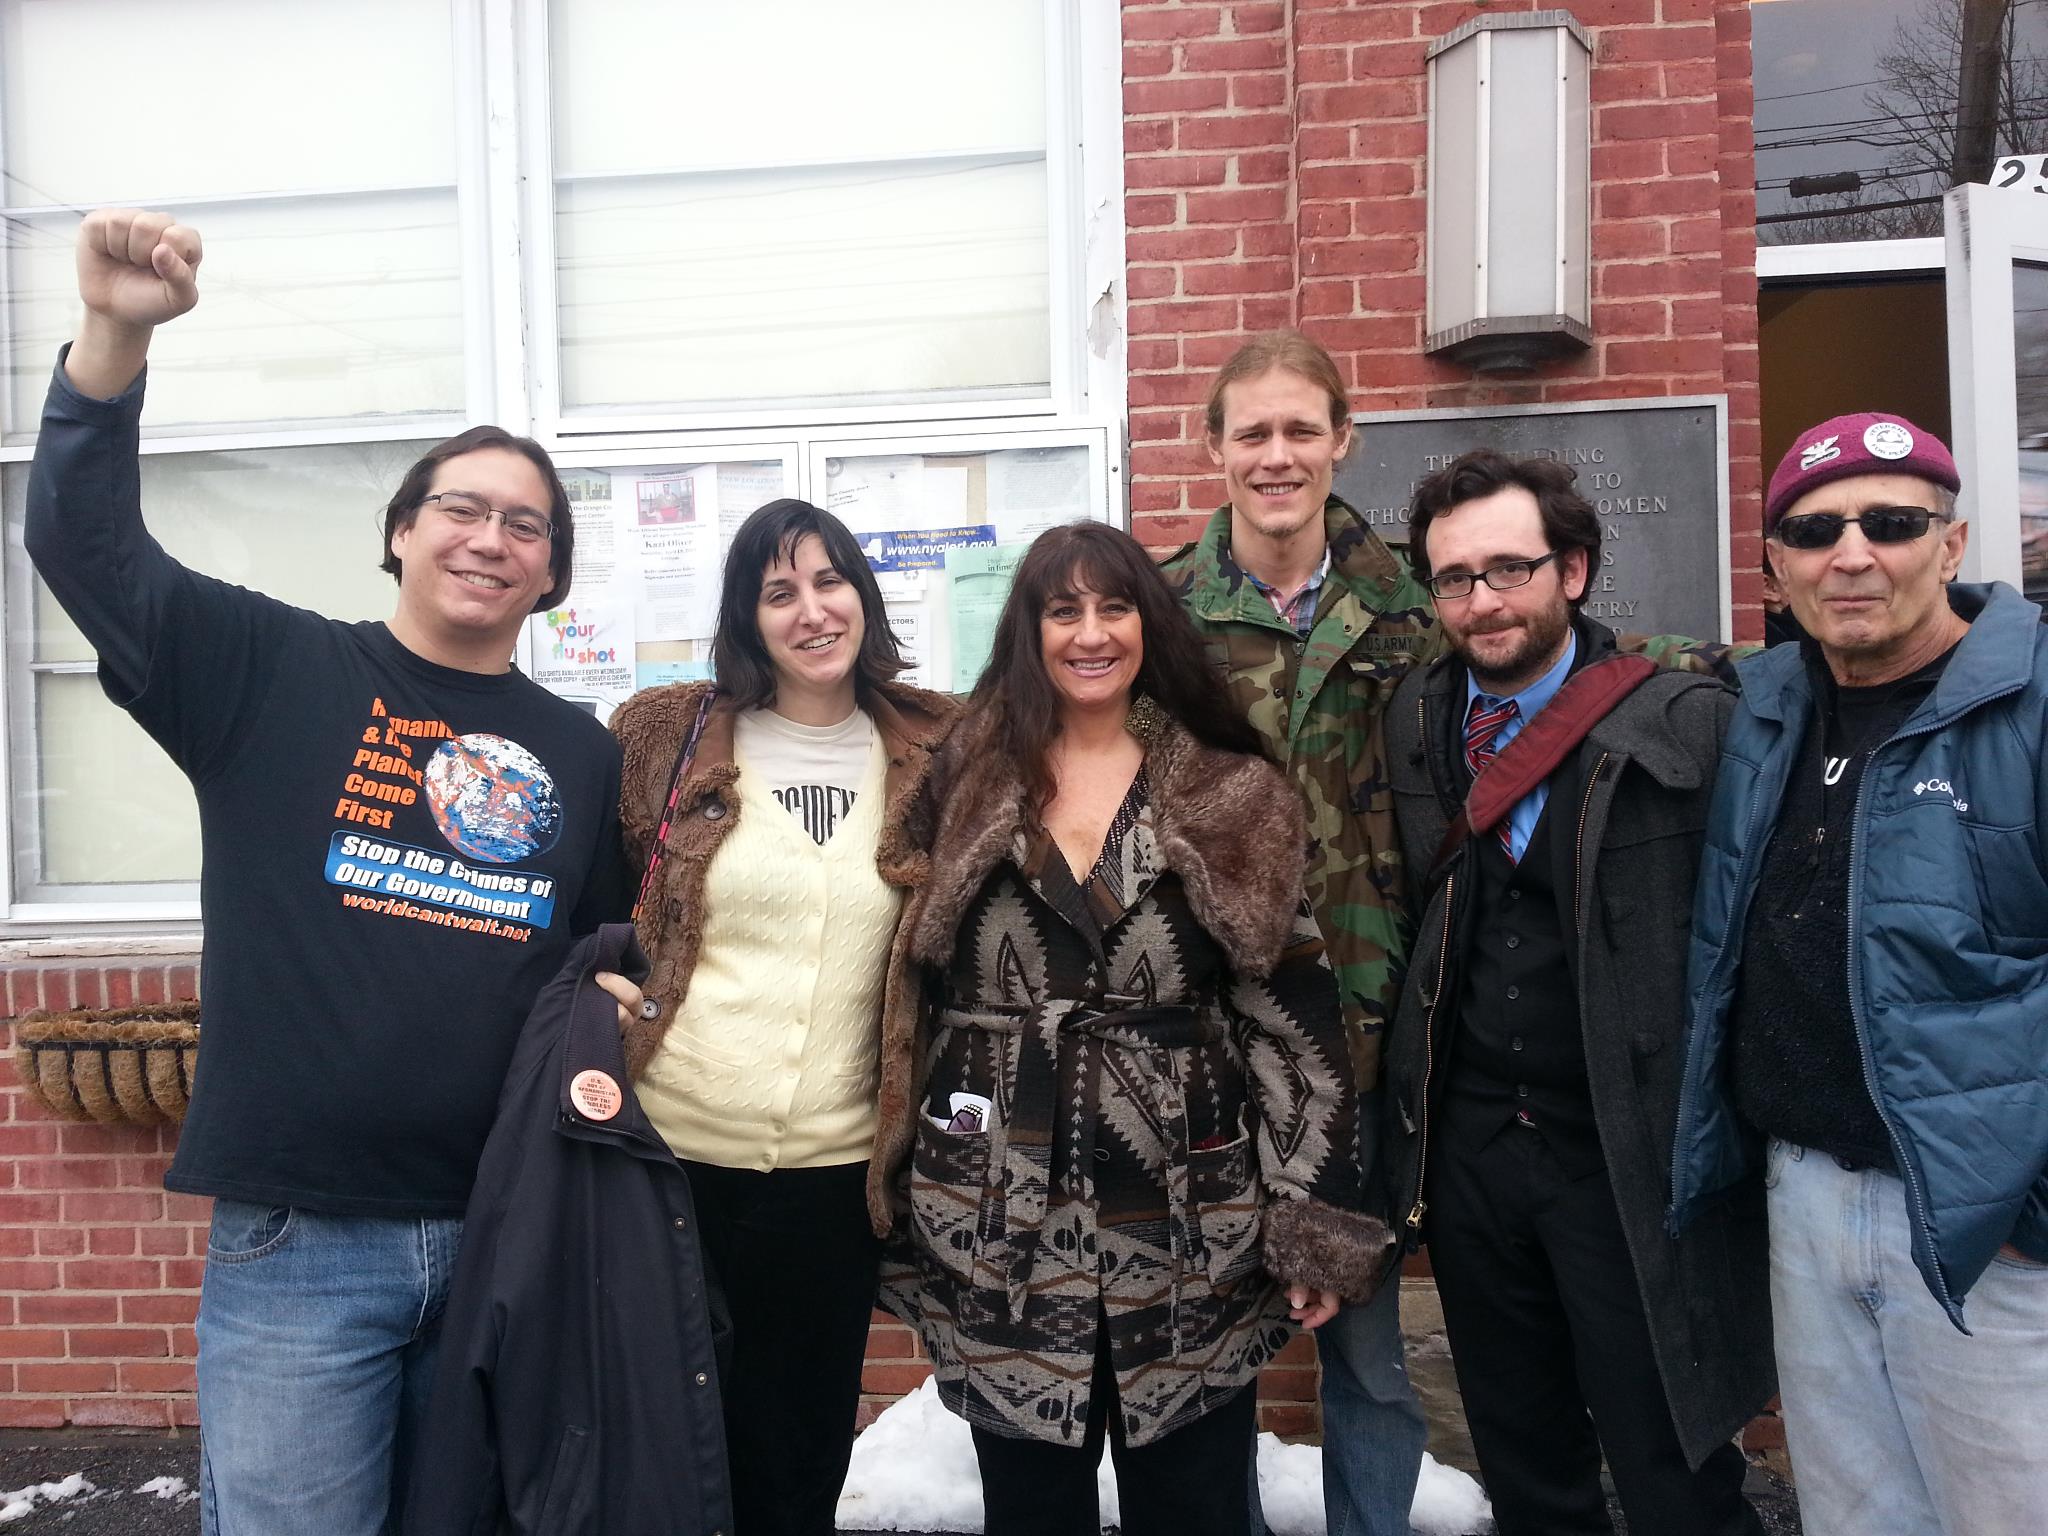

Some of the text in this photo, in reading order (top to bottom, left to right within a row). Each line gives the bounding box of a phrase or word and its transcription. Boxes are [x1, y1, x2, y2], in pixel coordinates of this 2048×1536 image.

[1591, 471, 1623, 490] TO
[1365, 496, 1668, 525] THO OMEN
[546, 608, 577, 628] get
[556, 624, 595, 642] your
[578, 647, 616, 664] shot
[362, 726, 381, 744] &
[344, 773, 417, 806] Come
[334, 798, 394, 830] First
[340, 835, 401, 865] Stop
[403, 850, 446, 875] the
[448, 860, 528, 893] Crimes
[334, 863, 531, 919] Our Government
[342, 893, 532, 943] worldcantwait.net
